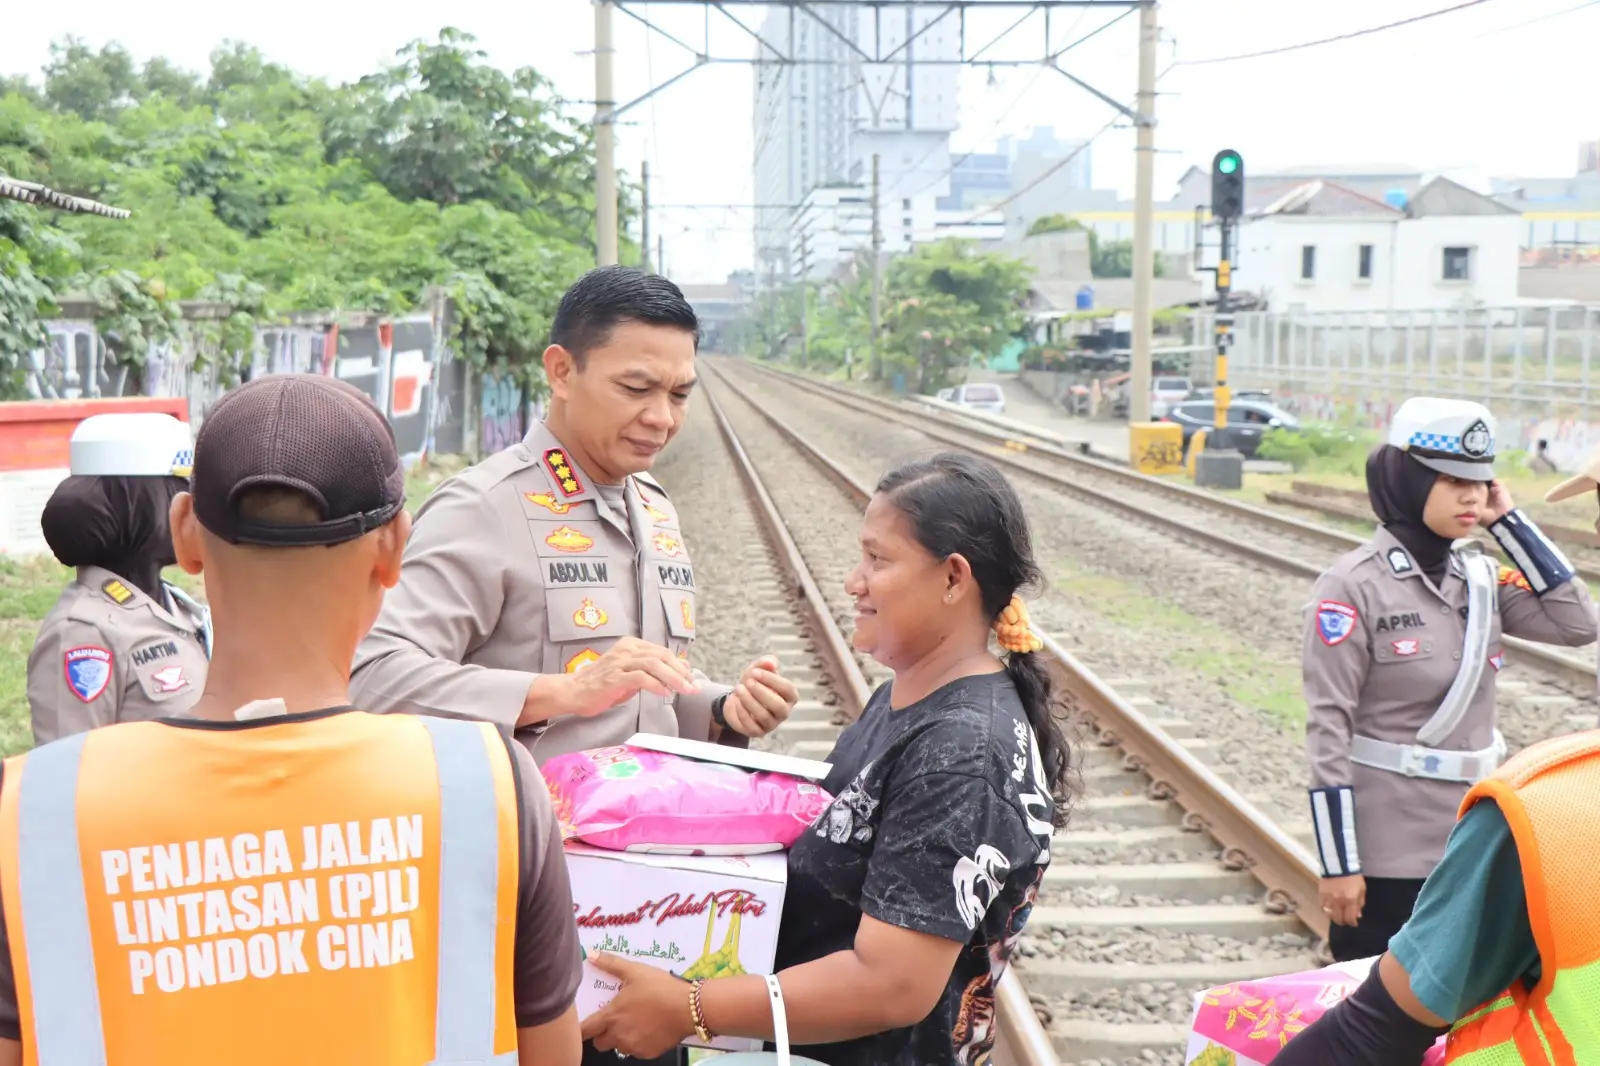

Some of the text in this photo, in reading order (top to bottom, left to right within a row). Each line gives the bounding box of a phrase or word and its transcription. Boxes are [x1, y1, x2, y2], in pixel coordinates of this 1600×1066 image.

[549, 562, 609, 583] ABDUL.W
[658, 565, 695, 588] POLRI
[1376, 612, 1427, 632] APRIL
[1012, 717, 1029, 755] ARE
[100, 814, 424, 895] PENJAGA JALAN
[111, 866, 419, 945] LINTASAN (PJL)
[128, 918, 415, 995] PONDOK CINA
